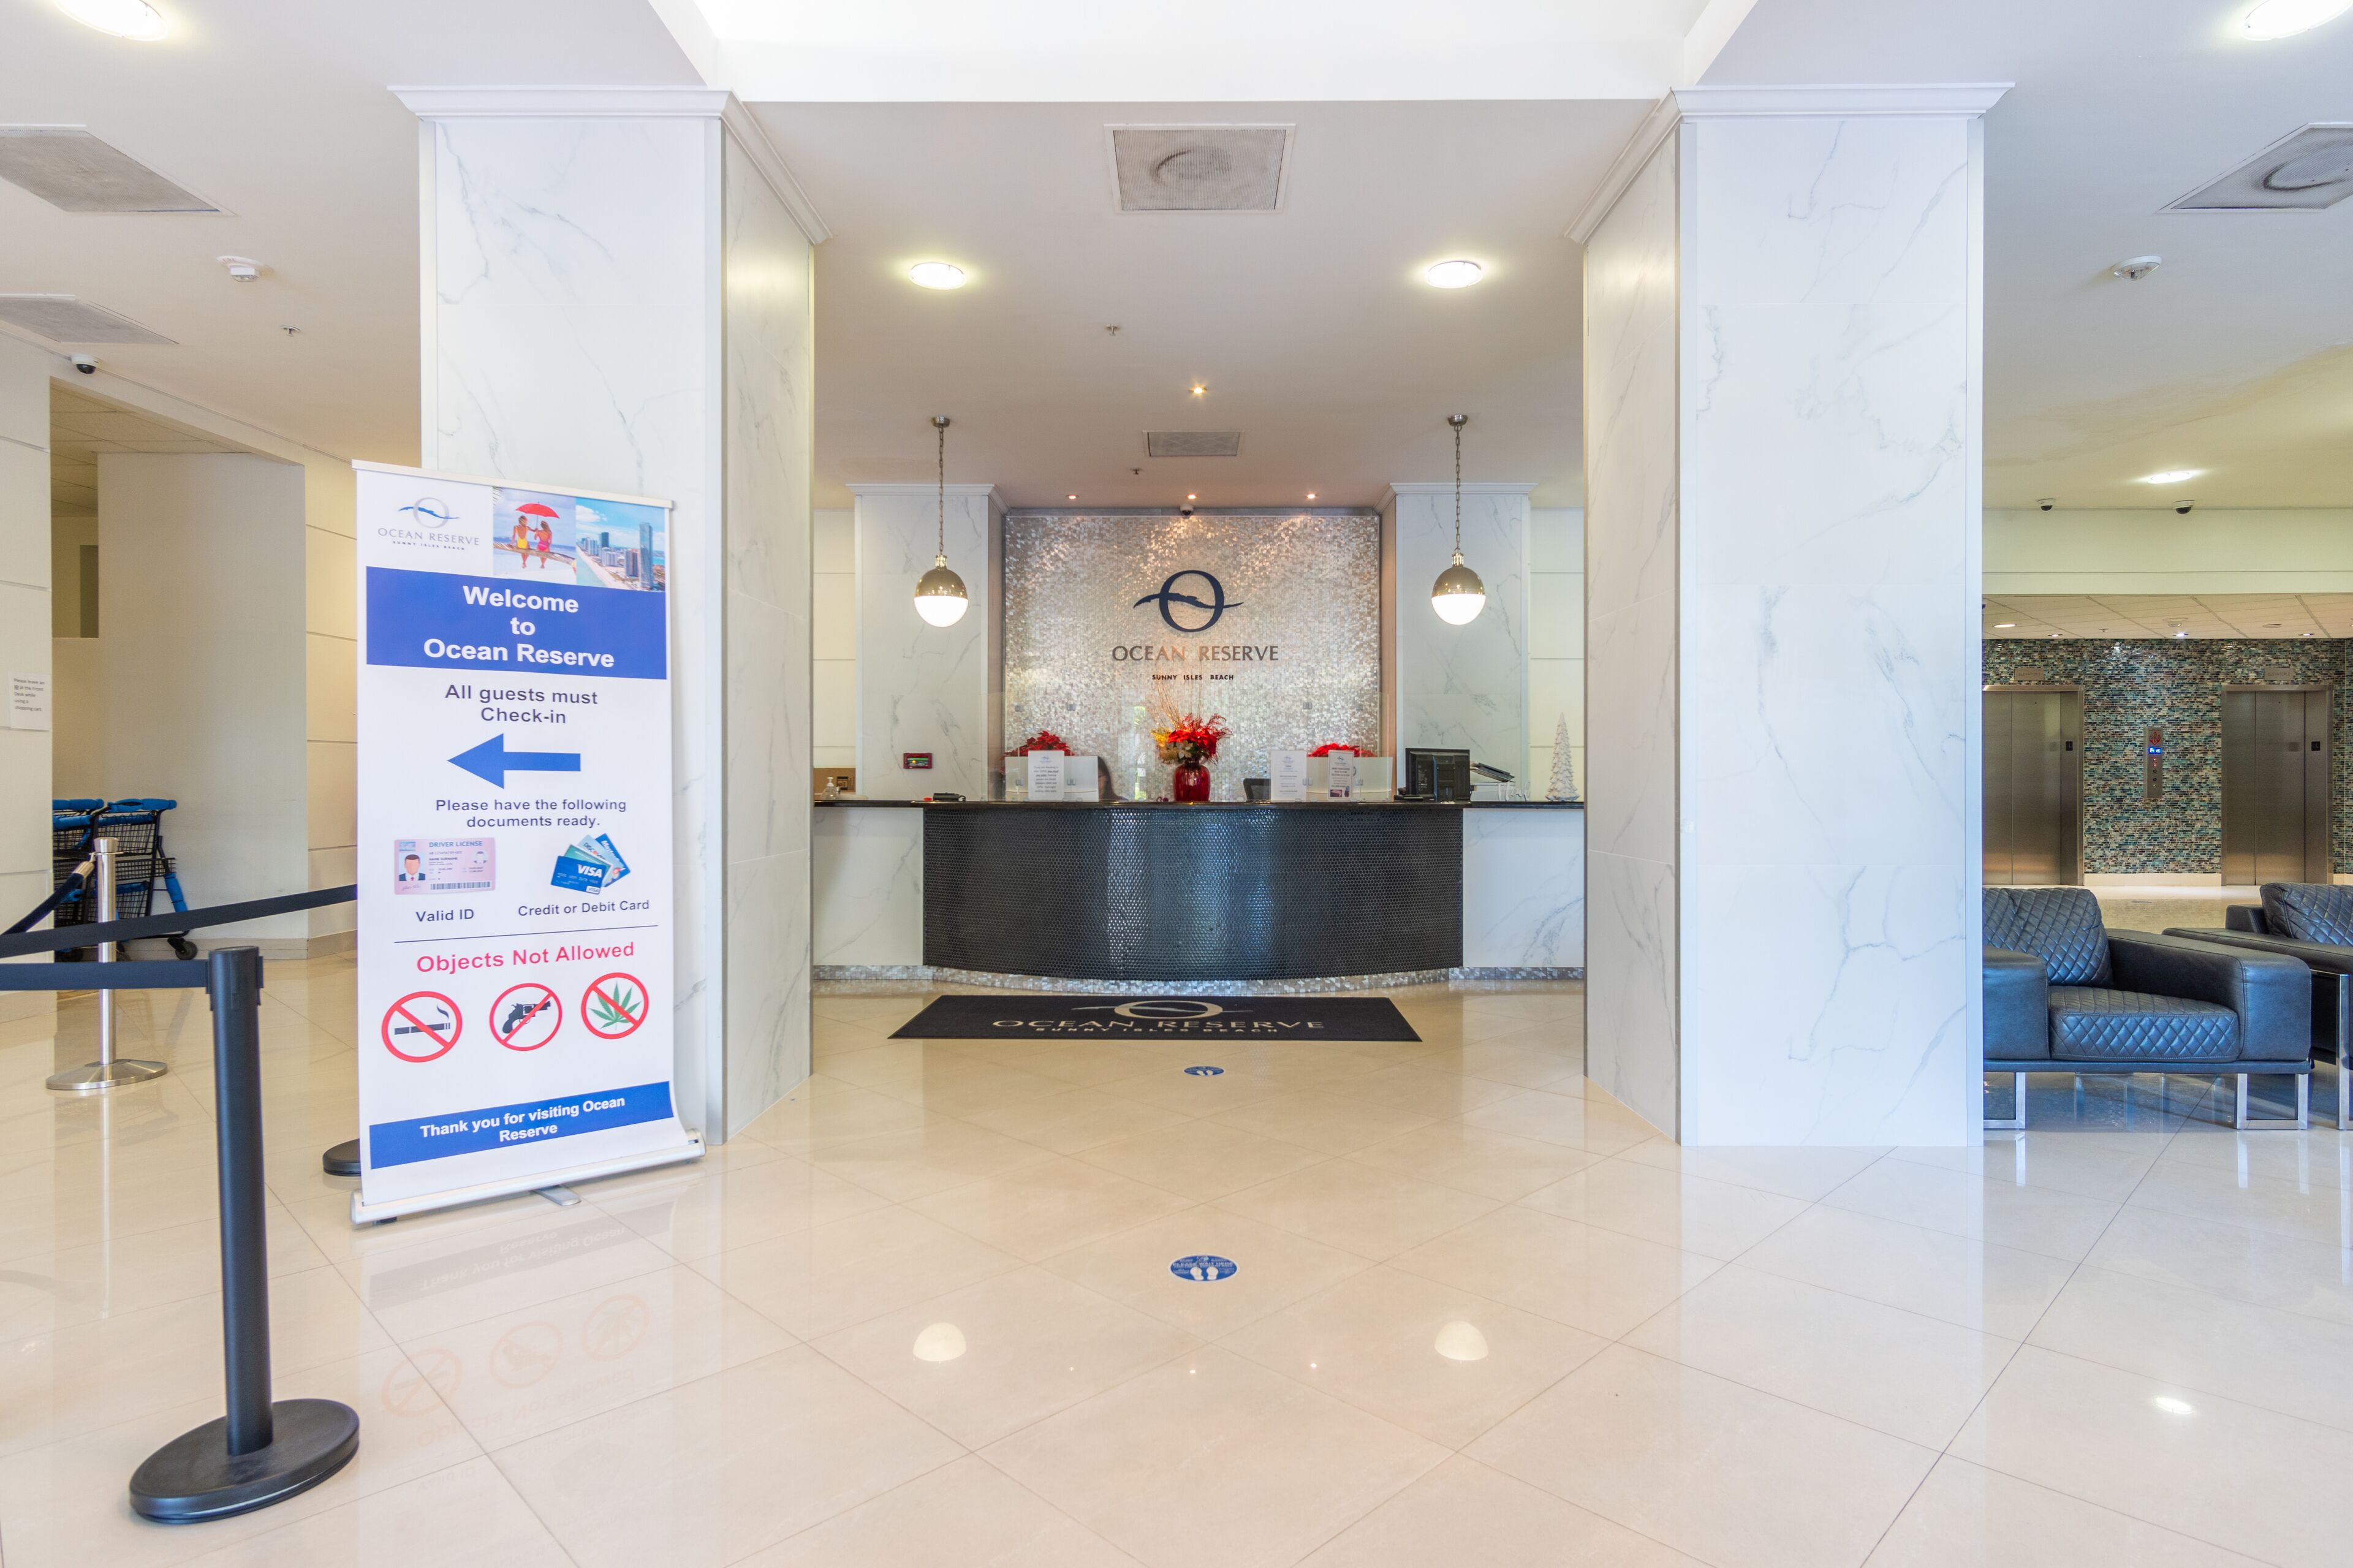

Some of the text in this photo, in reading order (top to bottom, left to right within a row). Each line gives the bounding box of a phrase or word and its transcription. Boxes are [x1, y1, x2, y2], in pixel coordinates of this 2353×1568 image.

[377, 527, 480, 546] OCEAN RESERVE
[463, 585, 579, 613] Welcome
[510, 616, 536, 635] to
[423, 638, 615, 668] Ocean Reserve
[1112, 645, 1279, 662] OCEAN RESERVE
[444, 684, 598, 705] All guests must
[480, 706, 566, 724] Check-in
[436, 799, 627, 812] Please have the following
[466, 816, 601, 828] documents ready.
[577, 863, 602, 878] VISA
[415, 909, 474, 922] Valid ID
[518, 899, 650, 917] Credit or Debit Card
[416, 941, 634, 974] Objects Not Allowed
[992, 1020, 1324, 1029] OCEAN RESERVE
[420, 1096, 626, 1138] Thank you for visiting Ocean
[499, 1123, 558, 1143] Reserve
